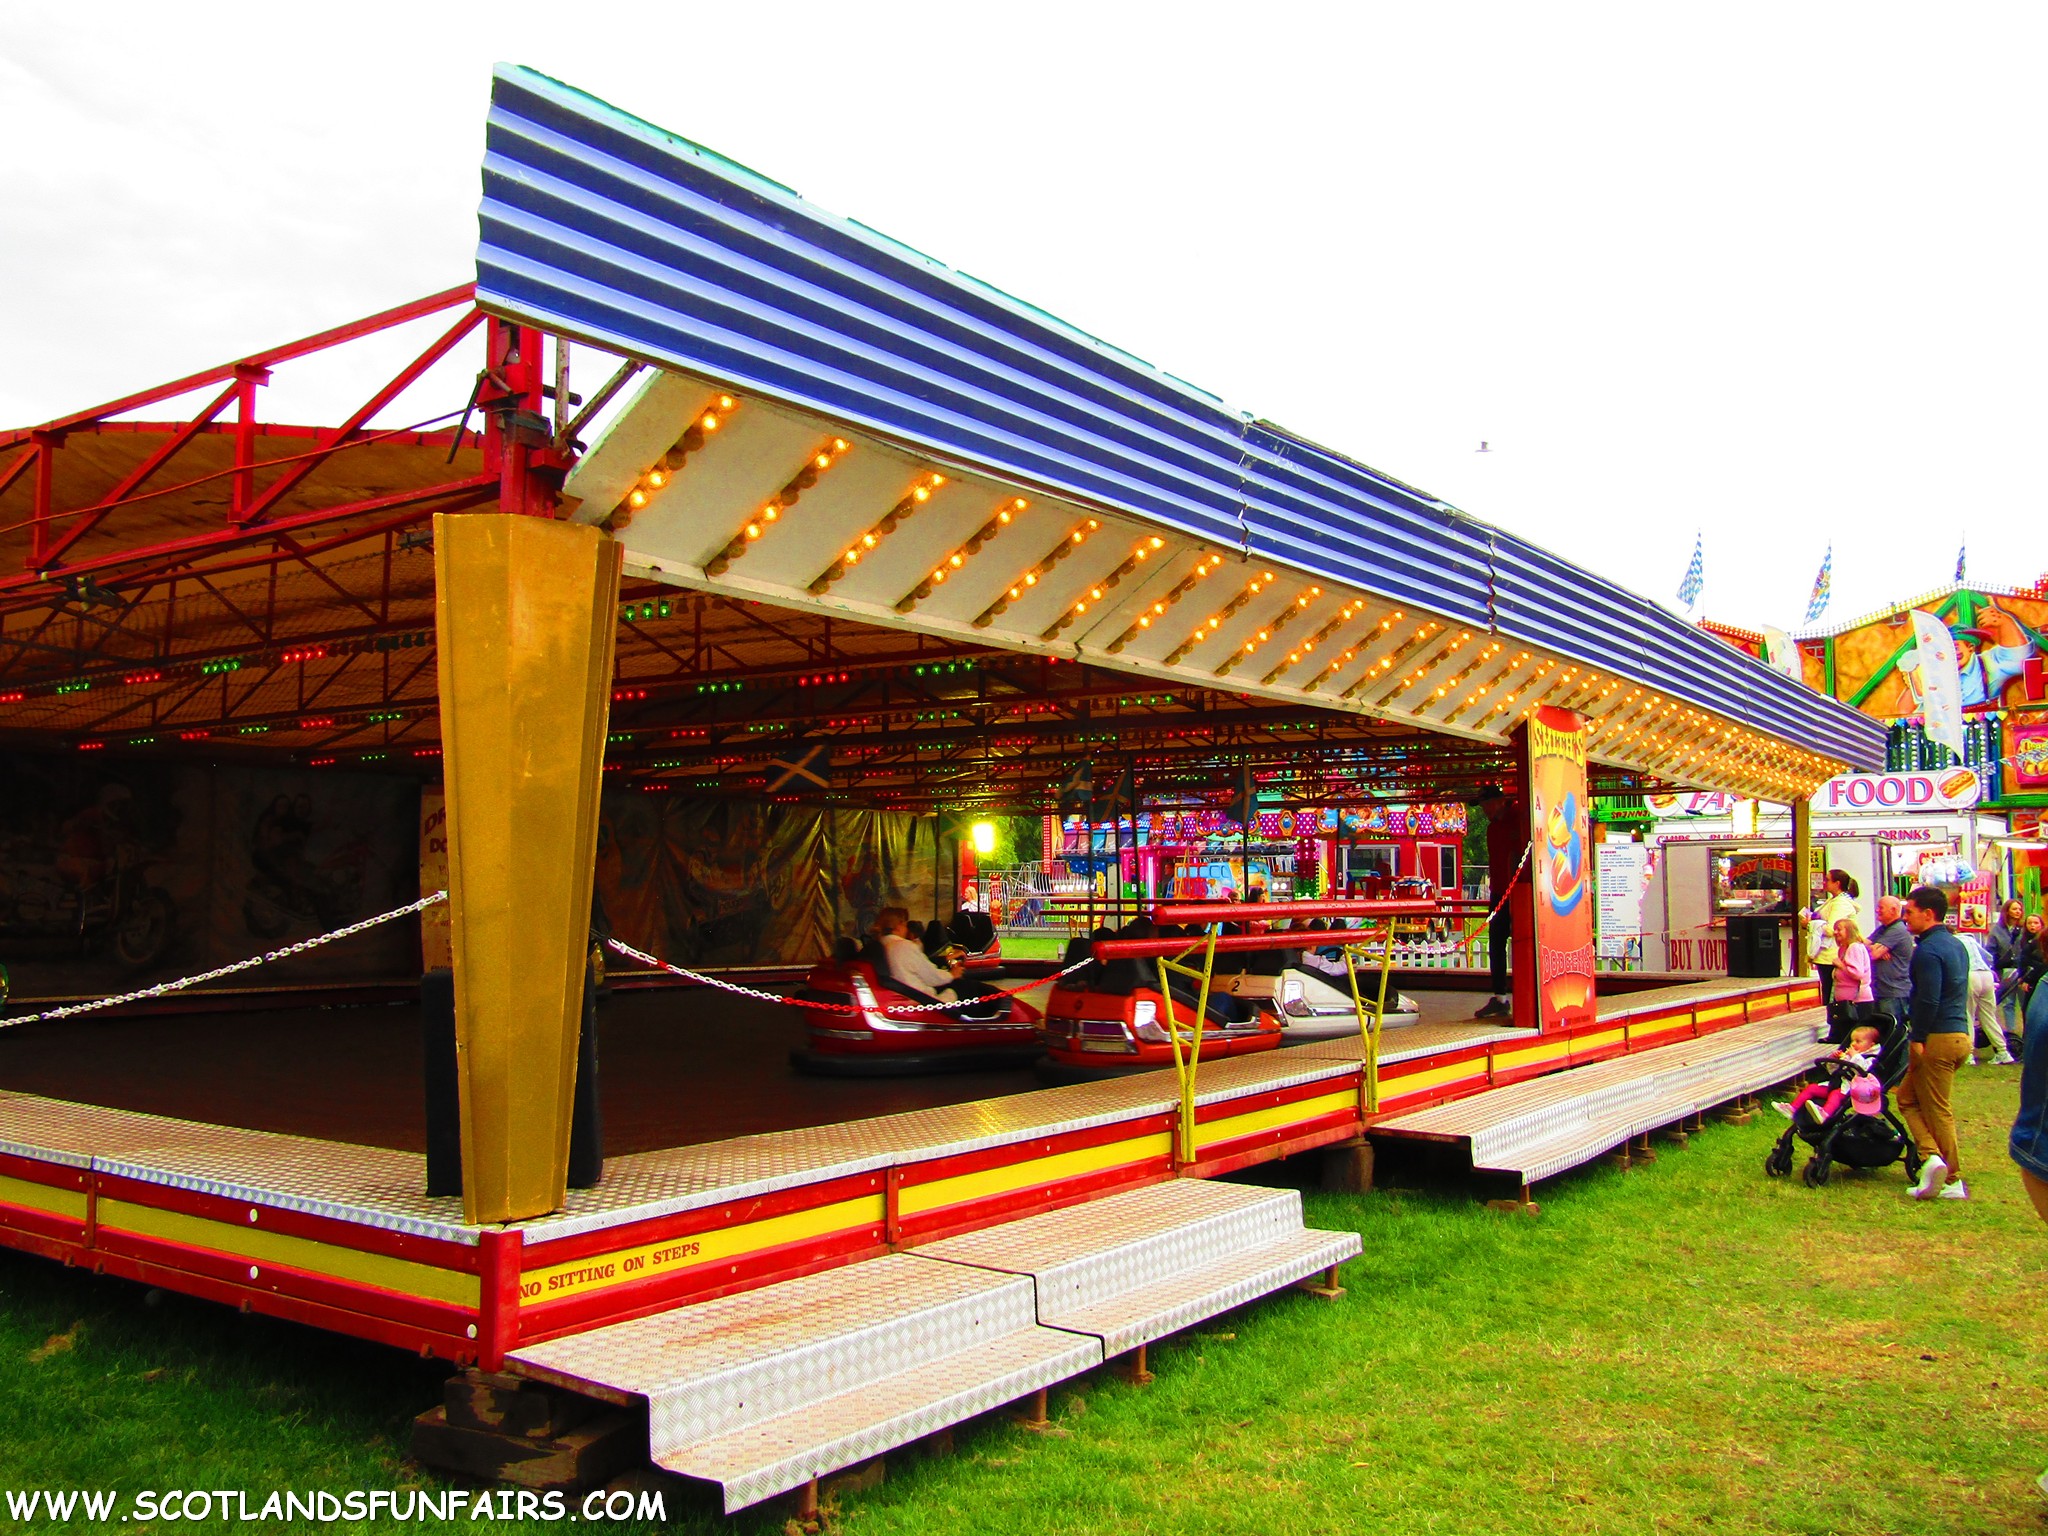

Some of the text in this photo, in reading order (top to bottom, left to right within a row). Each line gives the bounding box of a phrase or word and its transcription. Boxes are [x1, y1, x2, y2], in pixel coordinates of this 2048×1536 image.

[1829, 777, 1934, 807] FOOD
[1877, 829, 1931, 841] DRINKS
[1671, 939, 1728, 971] BUY YOUR
[1231, 981, 1241, 992] 2
[519, 1242, 700, 1299] NO SITTING ON STEPS
